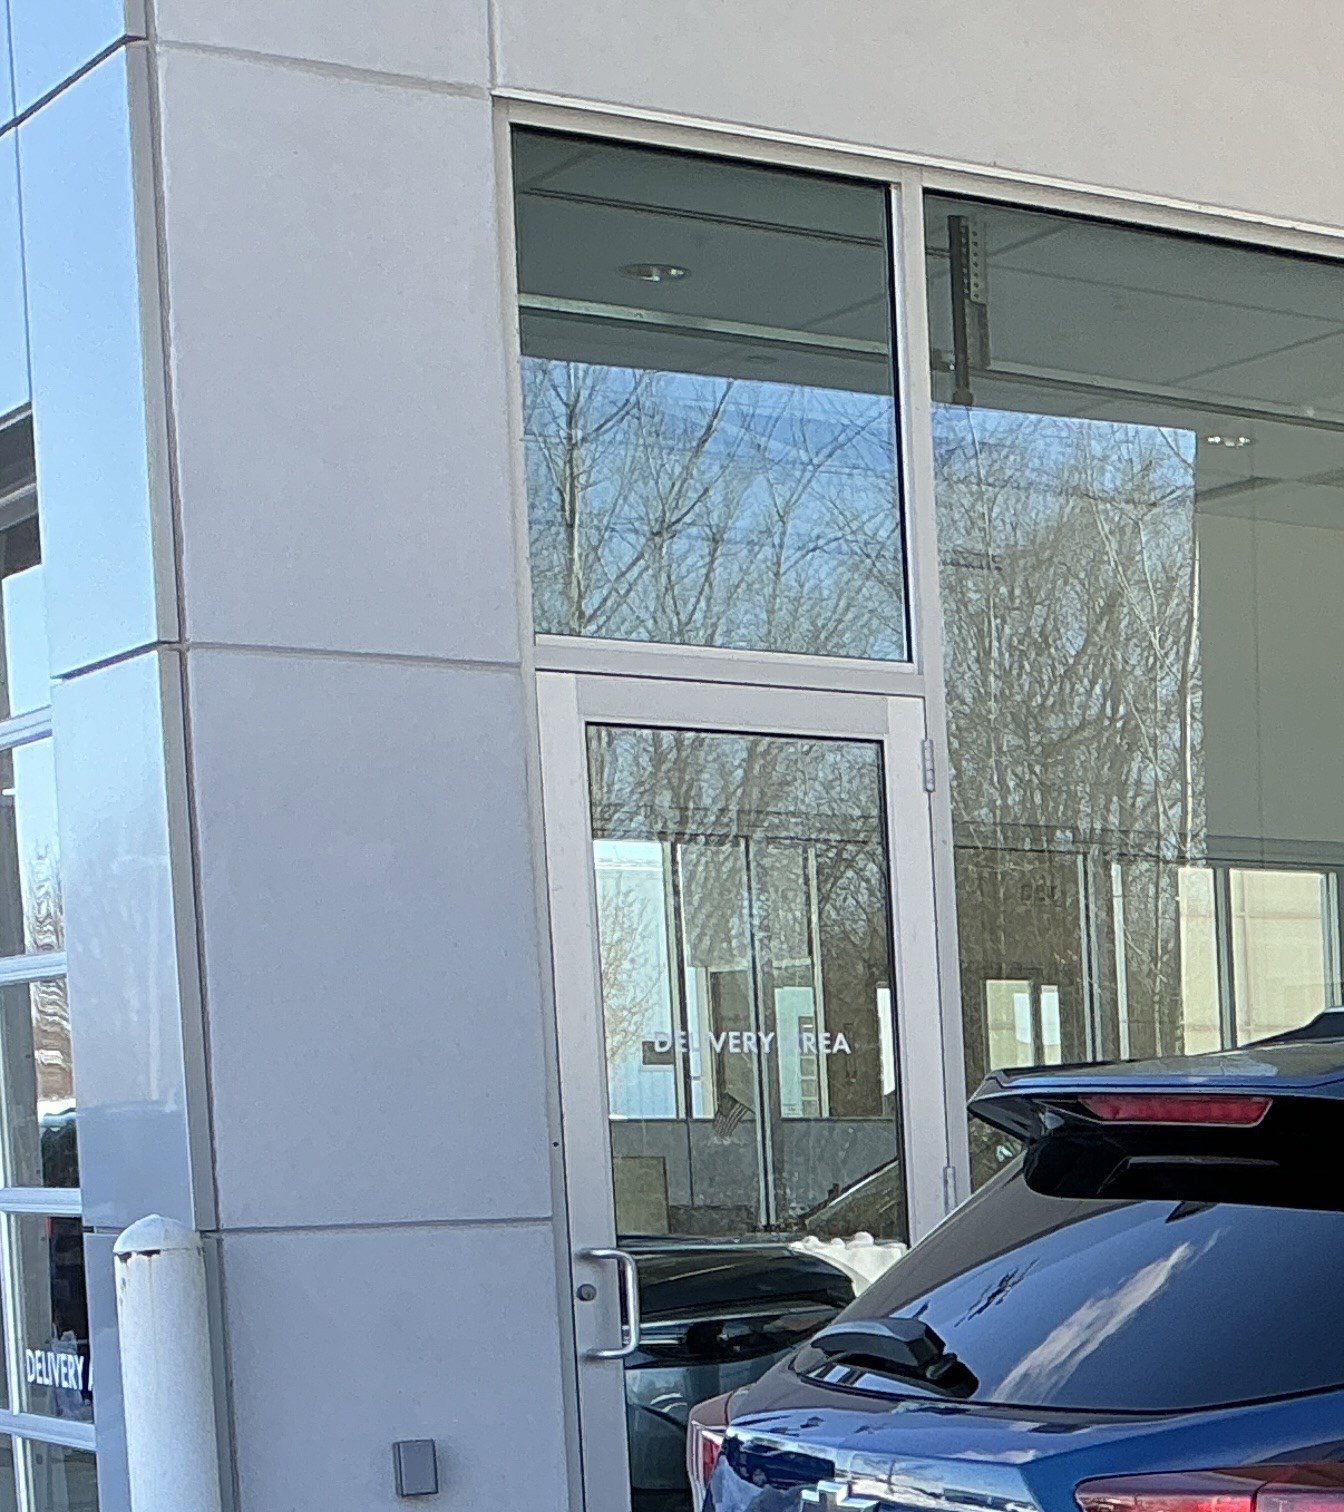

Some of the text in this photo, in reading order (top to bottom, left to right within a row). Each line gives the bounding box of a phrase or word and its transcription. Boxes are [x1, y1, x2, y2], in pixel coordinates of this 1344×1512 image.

[653, 1030, 851, 1055] DELVERY REA
[25, 1348, 85, 1390] DELIVERY
